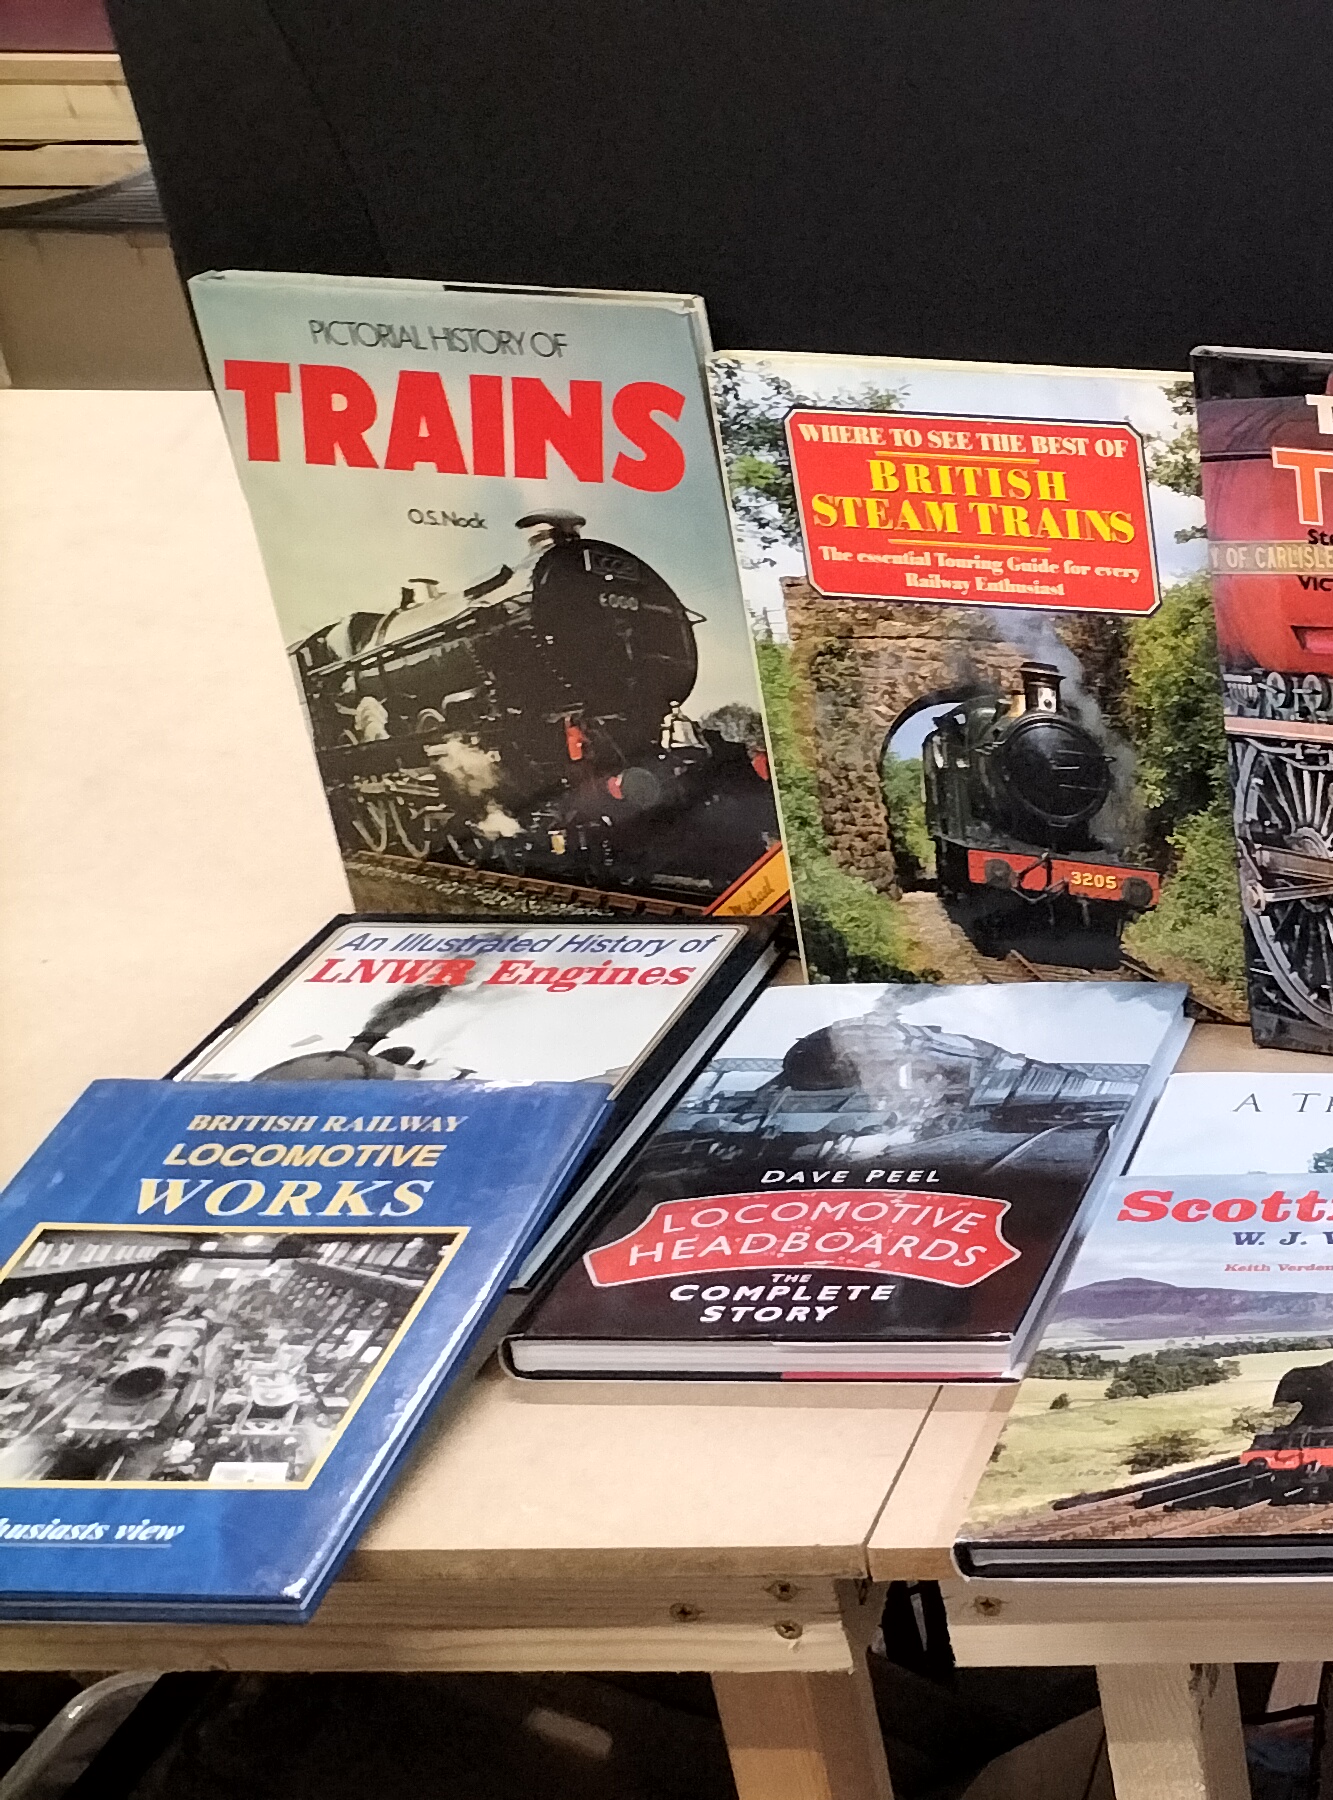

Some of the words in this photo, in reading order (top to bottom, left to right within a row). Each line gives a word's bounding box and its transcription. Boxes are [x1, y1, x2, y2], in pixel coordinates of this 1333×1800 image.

[308, 319, 427, 351] PICTORIAL
[428, 323, 526, 355] HISTORY
[531, 331, 569, 358] OF
[224, 359, 686, 492] TRAINS
[798, 423, 886, 446] WHERE
[889, 428, 922, 448] TO
[927, 429, 971, 450] SEE
[976, 433, 1026, 453] THE
[1032, 436, 1089, 456] BEST
[1095, 439, 1128, 458] OF
[867, 459, 1068, 502] BRITISH
[812, 493, 961, 534] STEAM
[969, 502, 1135, 544] TRAINS
[819, 546, 853, 563] The
[857, 549, 931, 567] essential
[934, 553, 1003, 574] Touring
[1007, 556, 1059, 574] Guide
[1063, 560, 1091, 576] for
[1094, 566, 1141, 583] every
[905, 572, 970, 595] Railway
[975, 576, 1065, 596] Enthusiast
[1070, 871, 1117, 890] 3205
[336, 933, 389, 951] An
[393, 933, 560, 954] Illustrated
[562, 934, 680, 957] History
[684, 935, 721, 954] of
[306, 958, 474, 985] LNWR
[483, 960, 697, 992] Engines
[1232, 1093, 1262, 1113] A
[186, 1115, 319, 1132] BRITISH
[322, 1116, 468, 1133] RAILWAY
[163, 1143, 448, 1168] LOCOMOTIVE
[759, 1170, 849, 1184] DAVE
[864, 1169, 941, 1184] PEEL
[134, 1178, 434, 1218] WORKS
[663, 1201, 988, 1236] LOCOMOTIVE
[629, 1229, 988, 1269] HEADBOARDS
[770, 1272, 813, 1284] THE
[1224, 1263, 1271, 1272] Keith
[668, 1283, 896, 1301] COMPLETE
[698, 1305, 840, 1322] STORY
[114, 1519, 185, 1541] view
